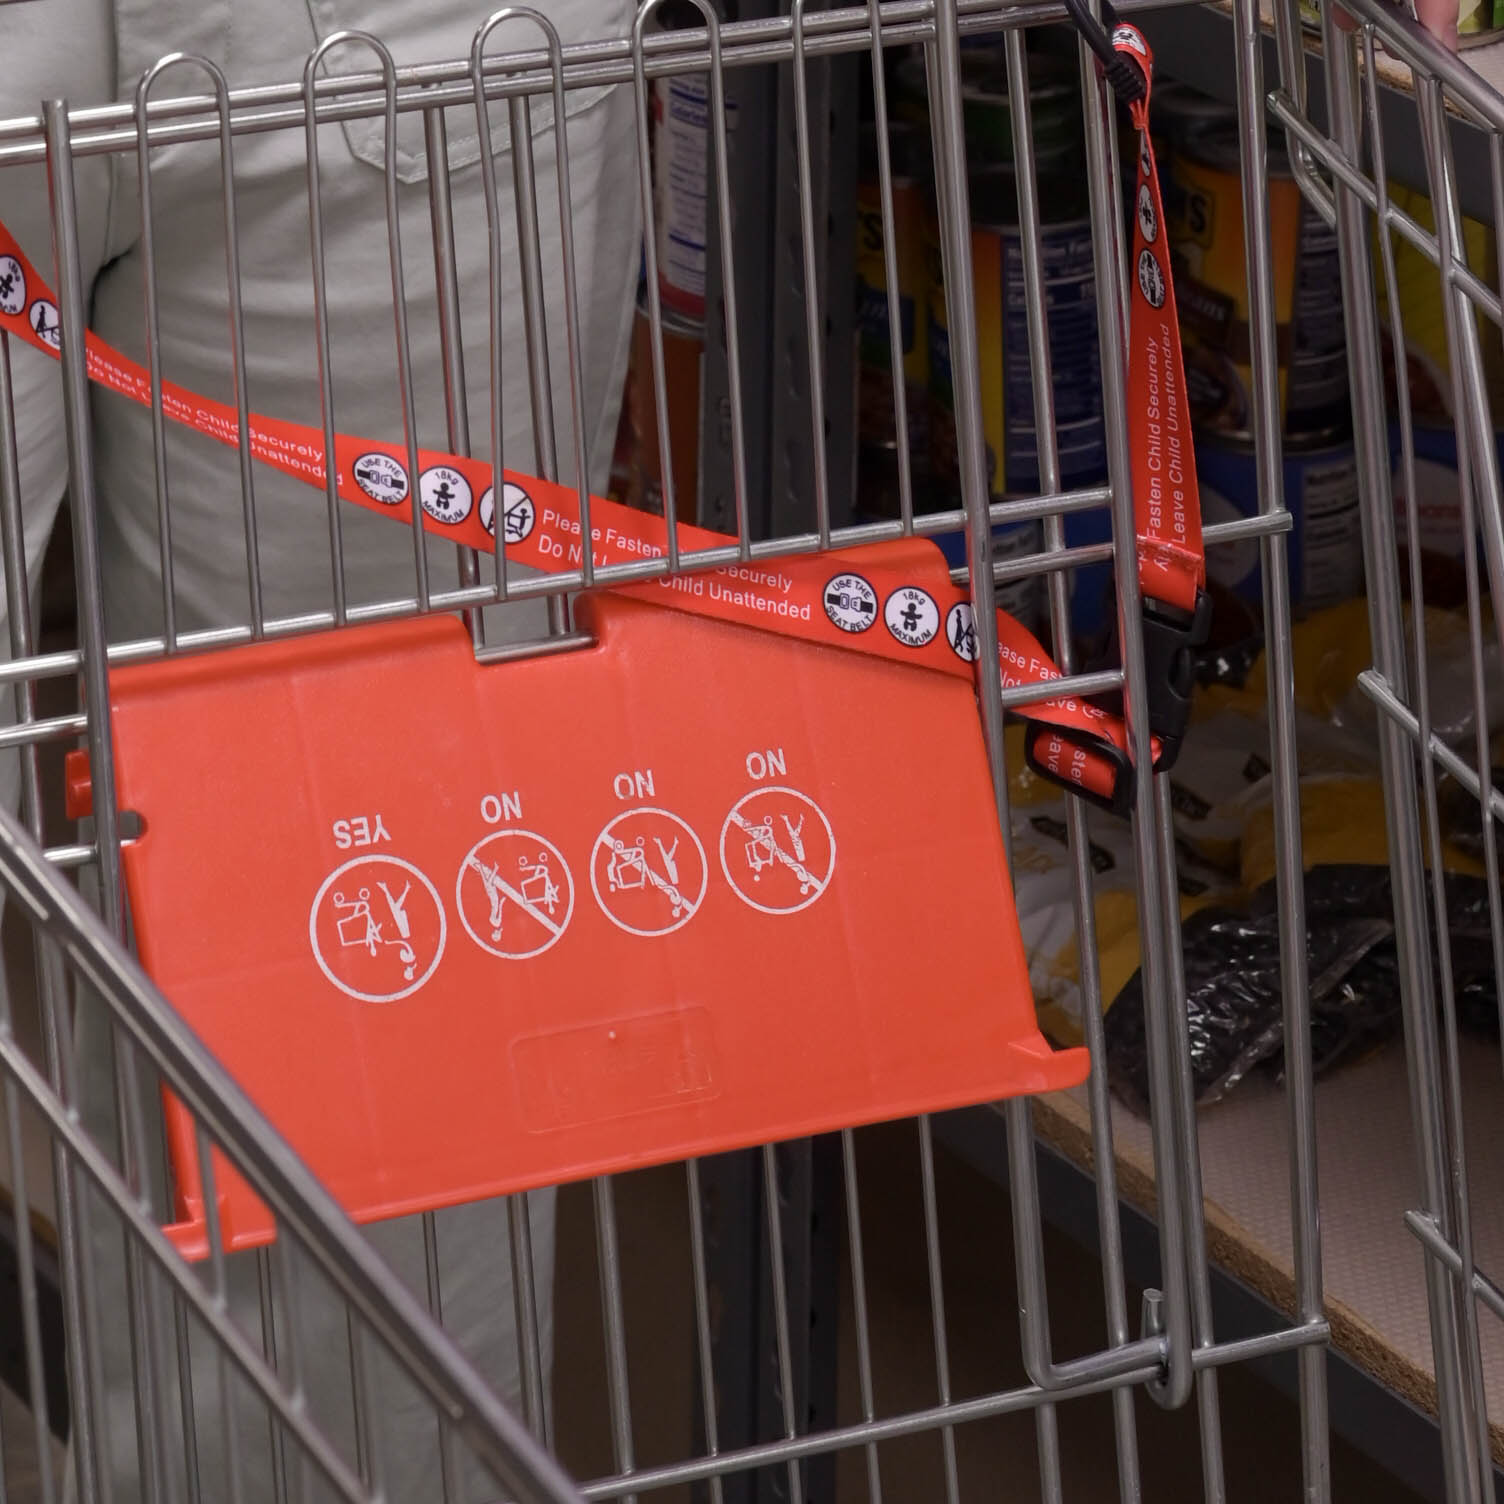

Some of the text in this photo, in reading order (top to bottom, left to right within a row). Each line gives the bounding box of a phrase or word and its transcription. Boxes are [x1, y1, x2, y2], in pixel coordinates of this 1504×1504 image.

[136, 378, 192, 414] Fsten
[248, 427, 323, 462] Securely
[1160, 323, 1186, 544] Leave Child Unattended
[1147, 336, 1162, 540] Fasten Child Securely
[384, 460, 402, 478] THE
[435, 470, 459, 486] 18kg
[381, 489, 403, 505] BELT
[422, 500, 465, 523] MAXIMUM
[543, 510, 601, 541] Pleae
[606, 528, 662, 559] Fasten
[539, 534, 563, 558] Do
[709, 583, 811, 622] Unattended
[832, 579, 872, 600] USE THE
[902, 591, 926, 606] 18kg
[827, 605, 873, 632] SEAT BELT
[890, 623, 932, 647] MAXIMUM
[997, 642, 1026, 669] ease
[746, 748, 787, 780] NO
[613, 770, 656, 800] NO
[480, 791, 523, 824] NO
[333, 814, 392, 849] YES
